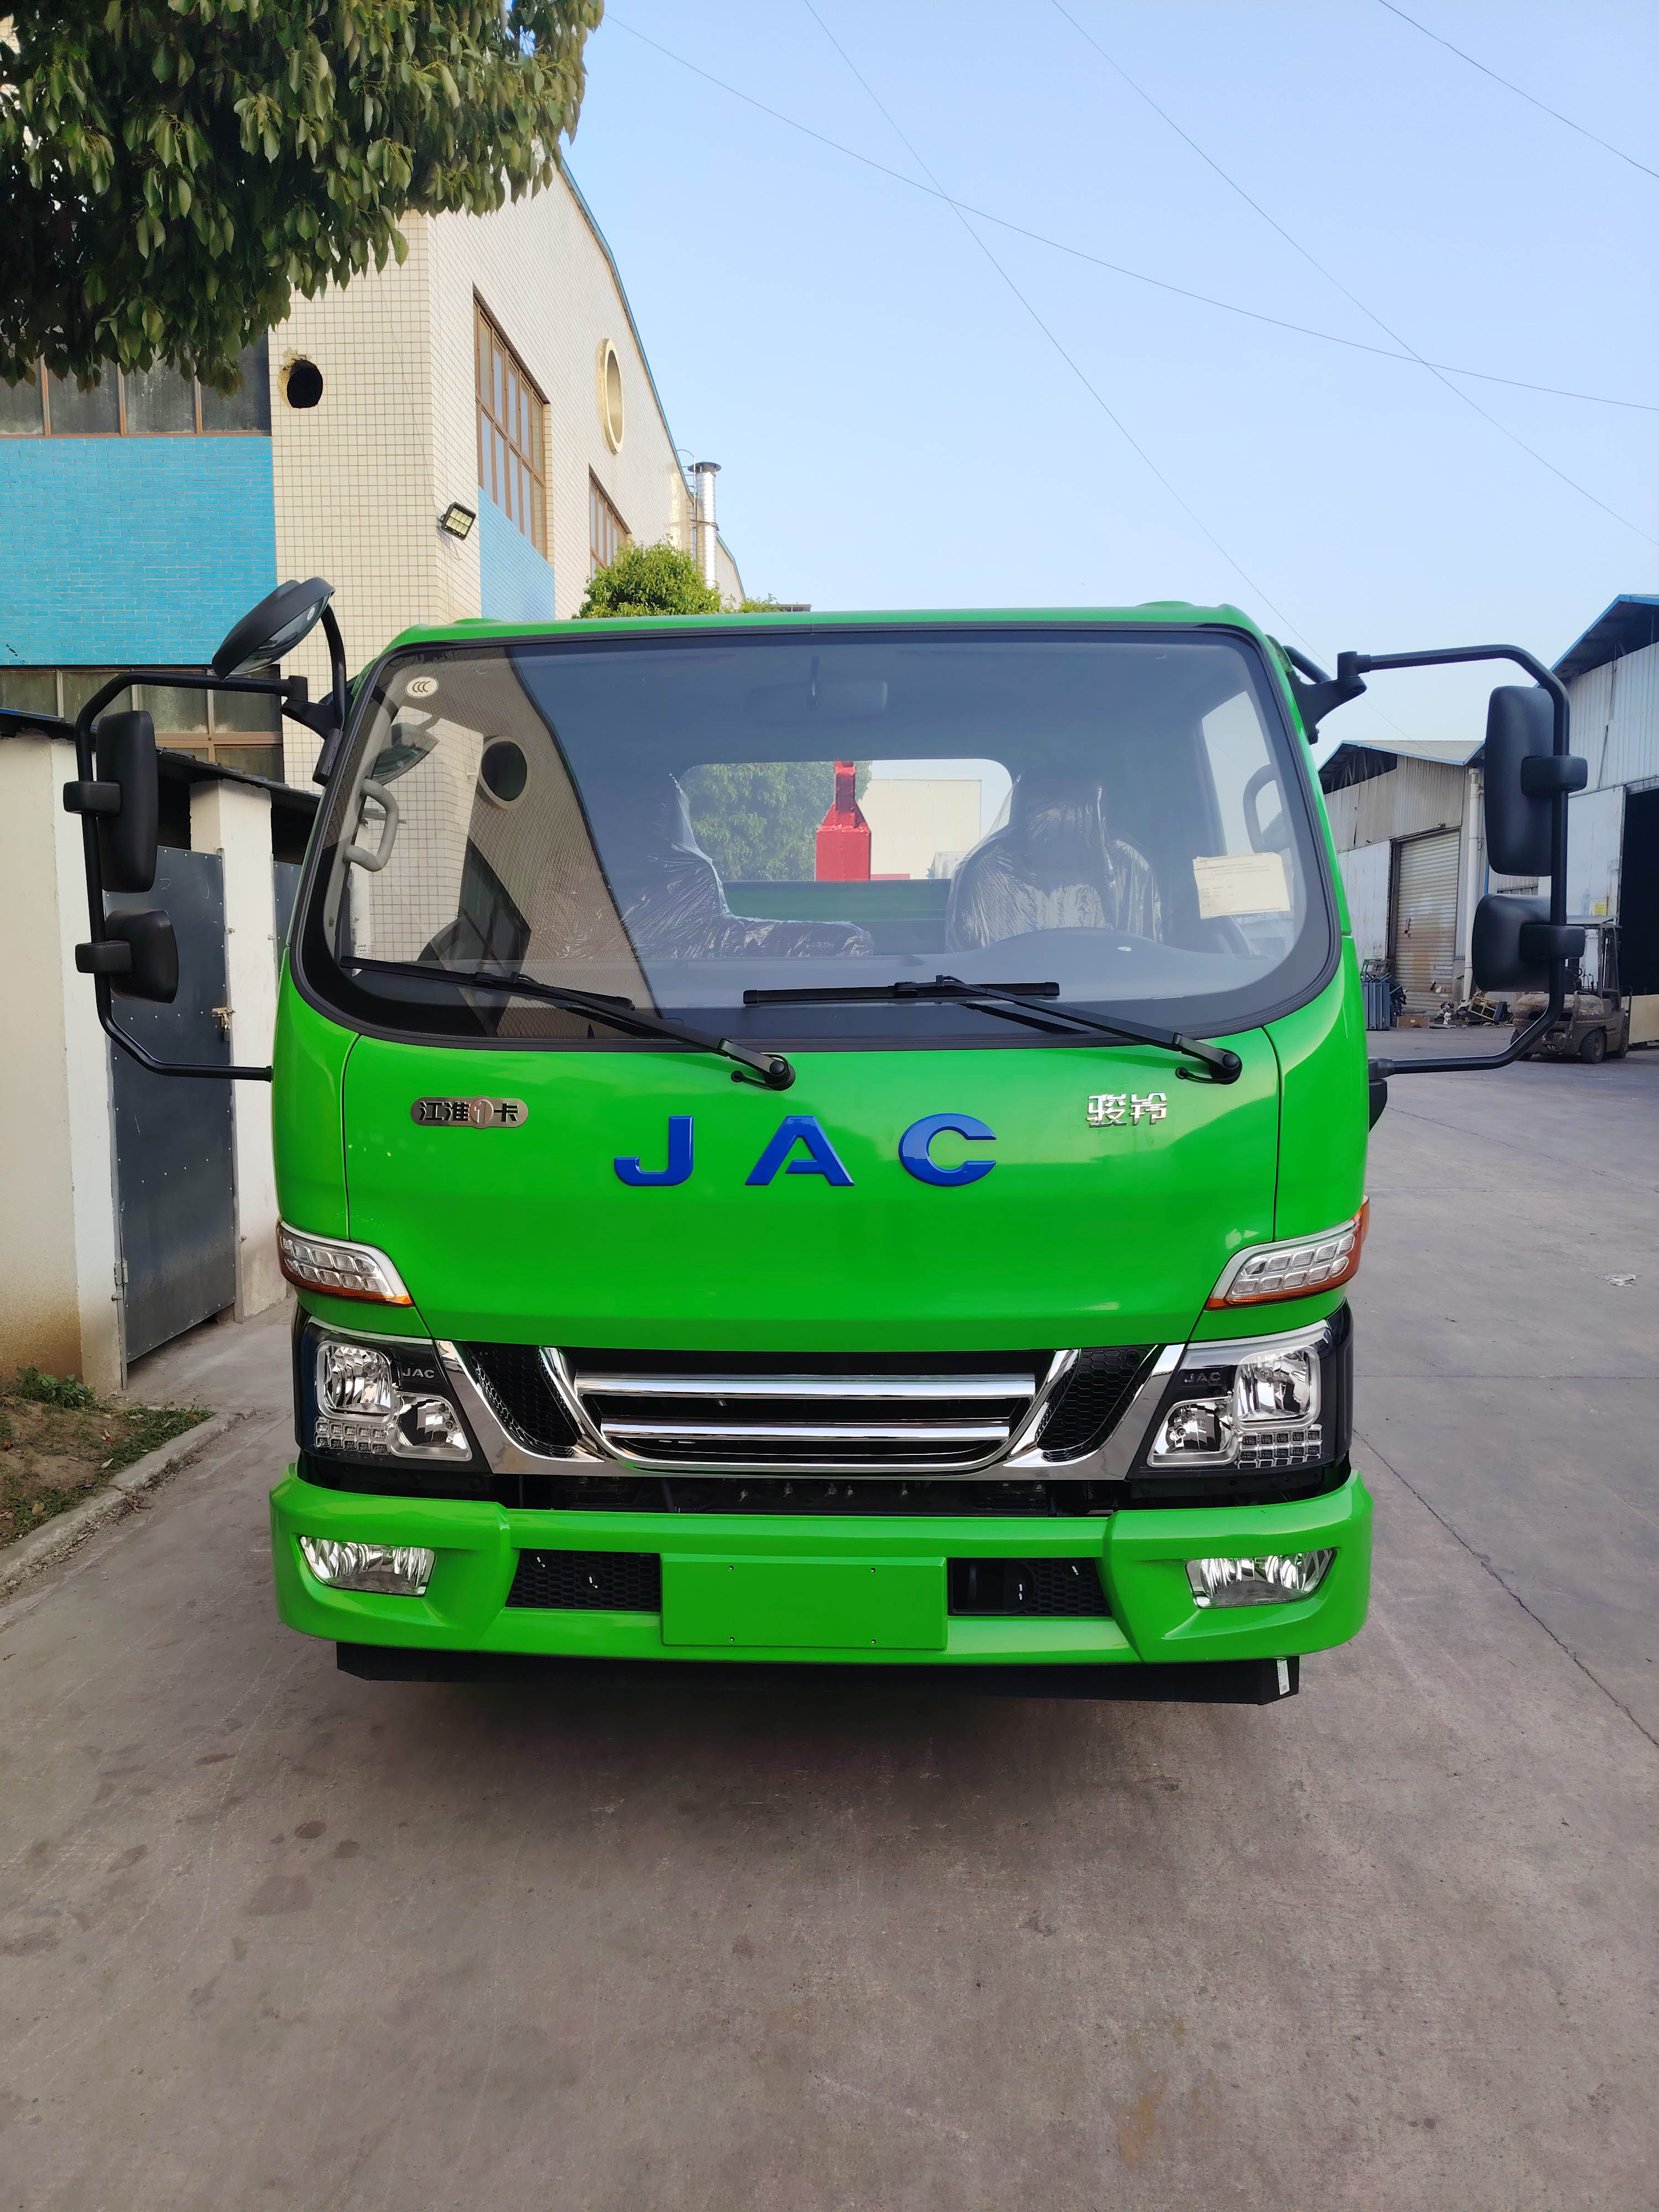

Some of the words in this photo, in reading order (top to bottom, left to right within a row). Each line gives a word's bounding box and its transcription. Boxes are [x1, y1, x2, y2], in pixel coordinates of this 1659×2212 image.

[1086, 1093, 1167, 1128] 骏铃
[614, 1113, 996, 1186] JAC
[403, 1368, 435, 1379] JAC
[1184, 1372, 1221, 1383] JAC
